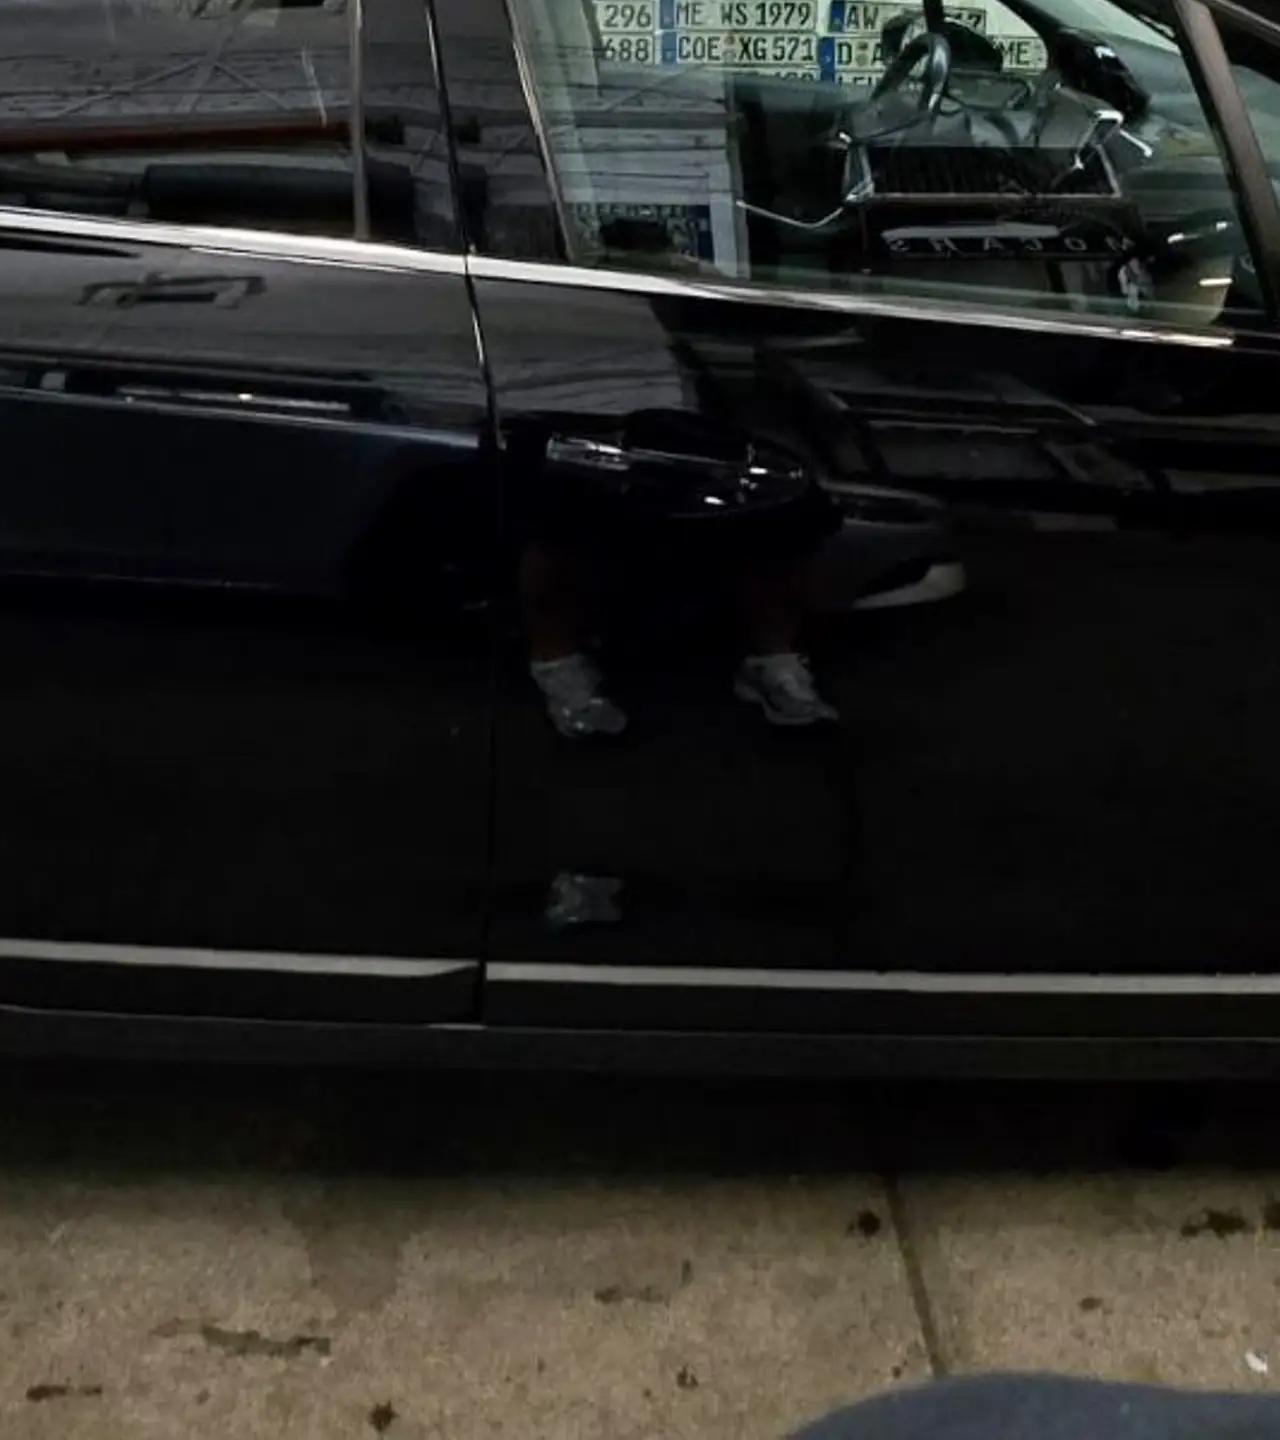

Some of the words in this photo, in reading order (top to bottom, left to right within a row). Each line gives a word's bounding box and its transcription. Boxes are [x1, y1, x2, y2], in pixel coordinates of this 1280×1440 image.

[678, 36, 720, 61] COE
[736, 36, 767, 61] XG
[772, 36, 815, 61] 571
